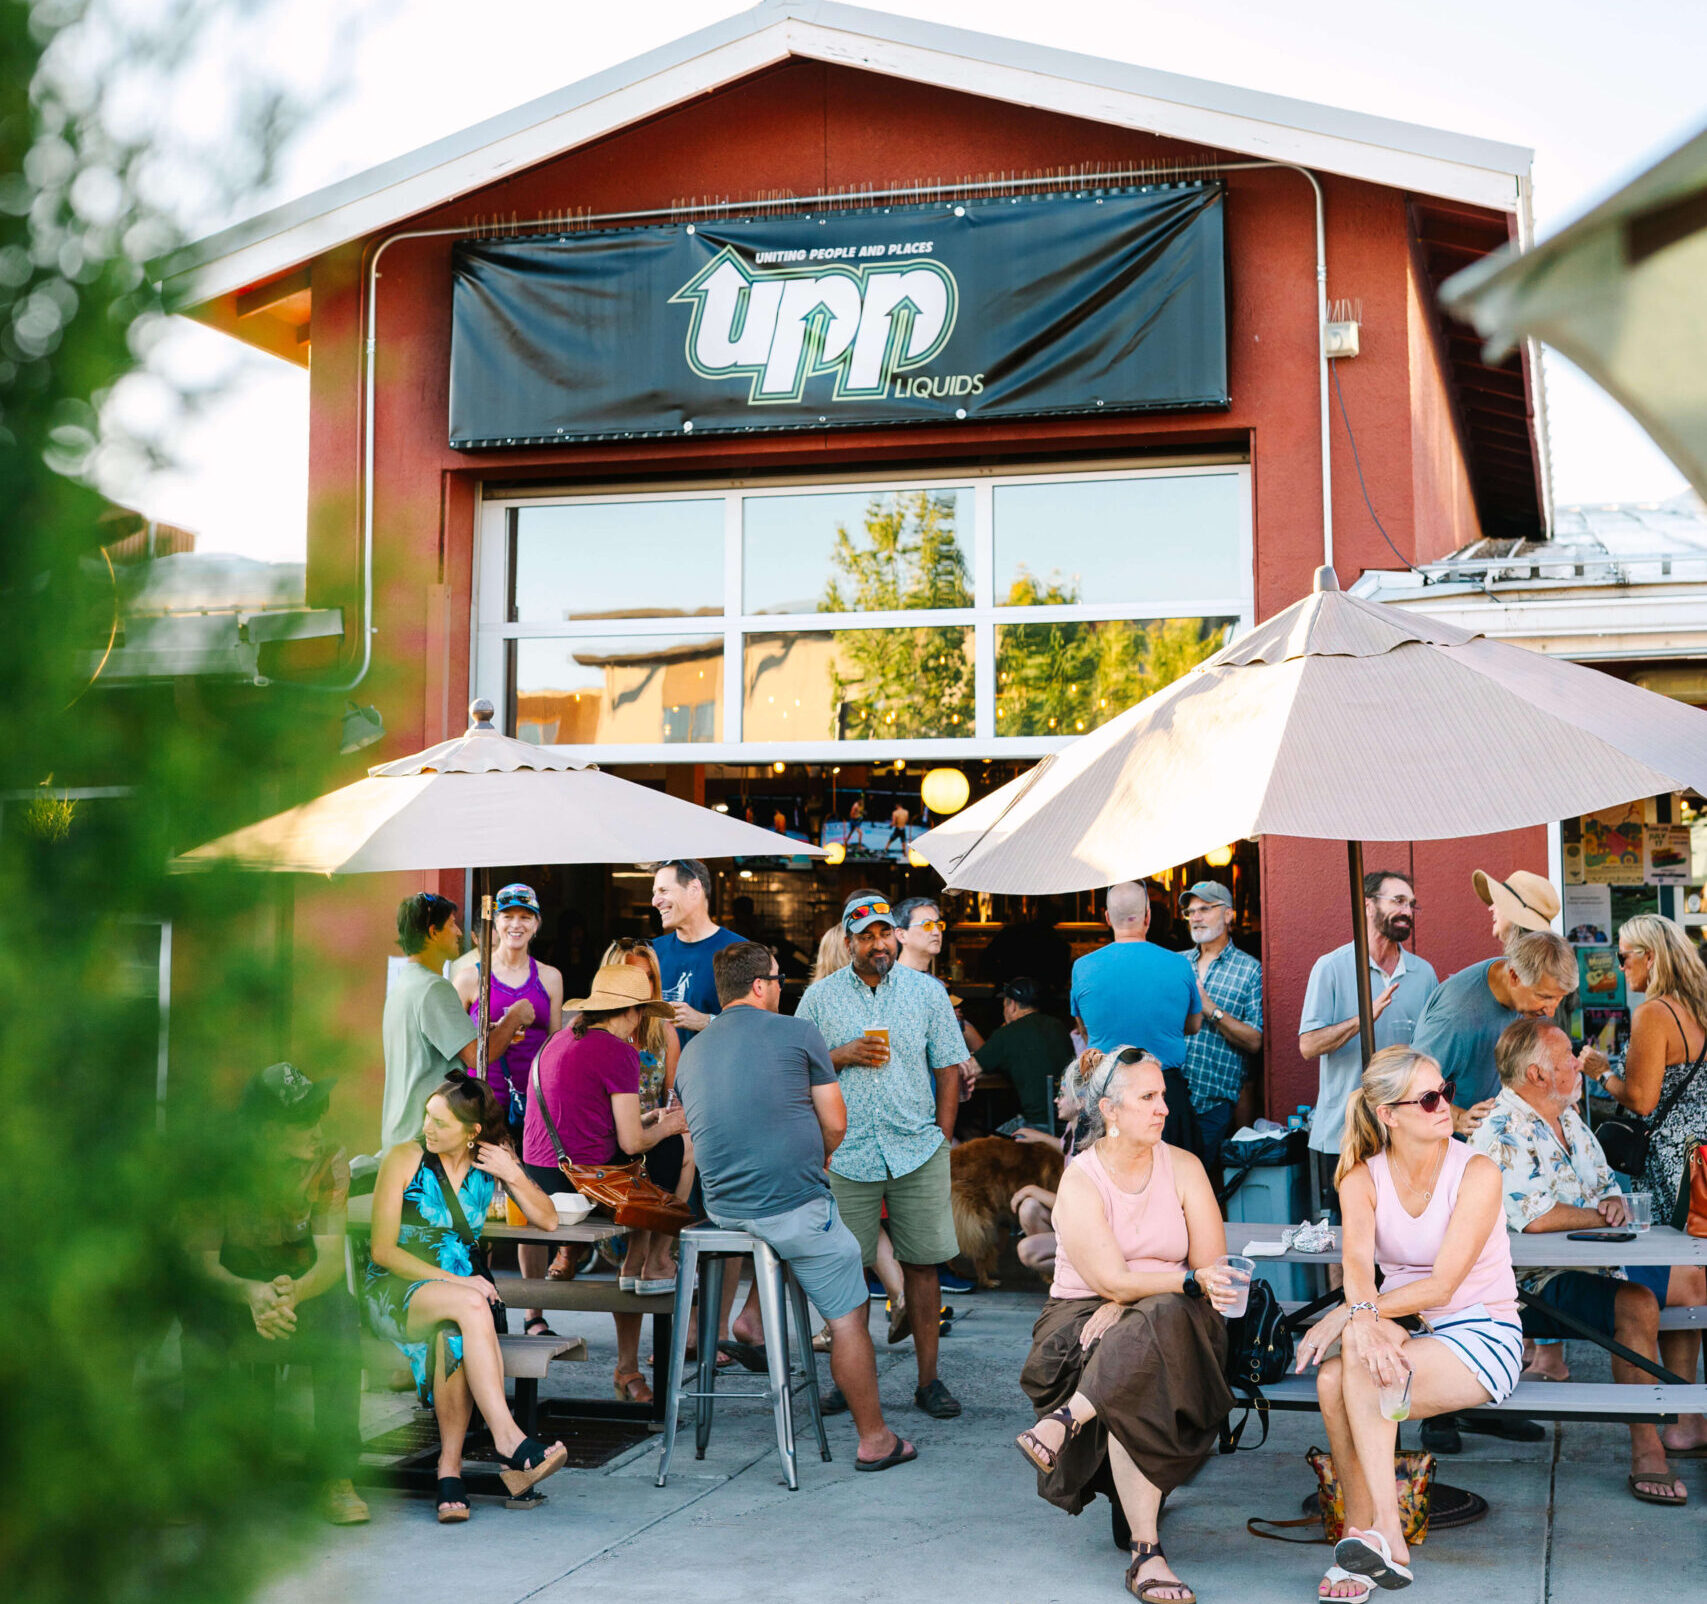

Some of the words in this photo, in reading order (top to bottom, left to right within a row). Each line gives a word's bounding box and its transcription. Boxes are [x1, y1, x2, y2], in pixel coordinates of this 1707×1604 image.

[755, 249, 807, 264] UNITING
[808, 246, 857, 260] PEOPLE
[858, 244, 887, 258] AND
[888, 241, 934, 255] PLACES
[894, 373, 985, 399] LIQUIDS
